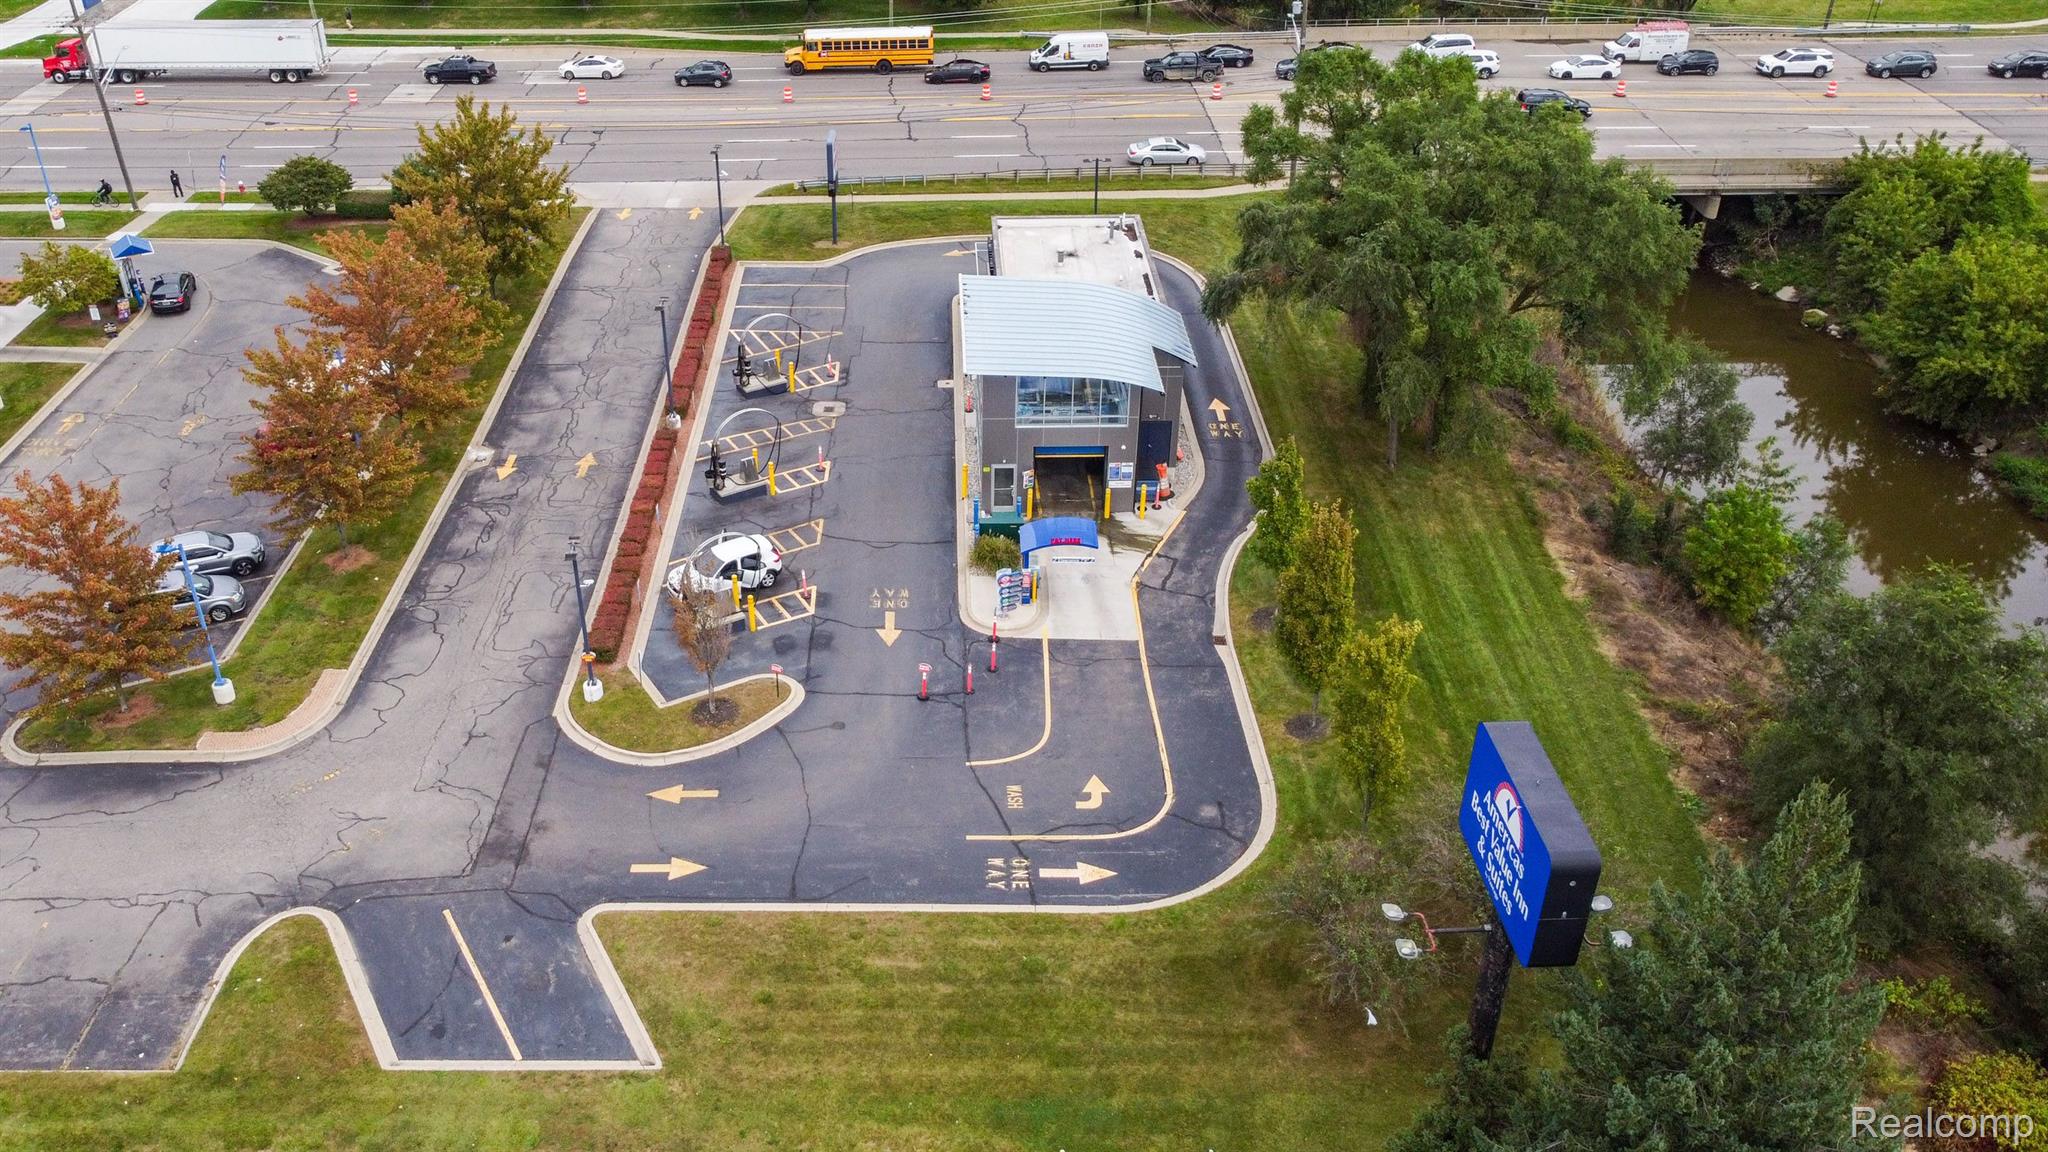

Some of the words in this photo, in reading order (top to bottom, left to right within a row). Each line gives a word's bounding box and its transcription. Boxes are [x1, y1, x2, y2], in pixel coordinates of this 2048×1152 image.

[1210, 430, 1243, 438] WAY
[870, 600, 908, 608] ONE
[872, 588, 909, 598] WAY
[1006, 784, 1024, 809] WASH
[1483, 790, 1525, 880] Americas
[1471, 789, 1490, 837] Best
[1491, 827, 1513, 886] Value
[1512, 878, 1529, 921] Inn
[986, 858, 1008, 891] WAY
[1012, 858, 1031, 889] ONE
[1477, 835, 1486, 859] &
[1486, 851, 1512, 916] Suites
